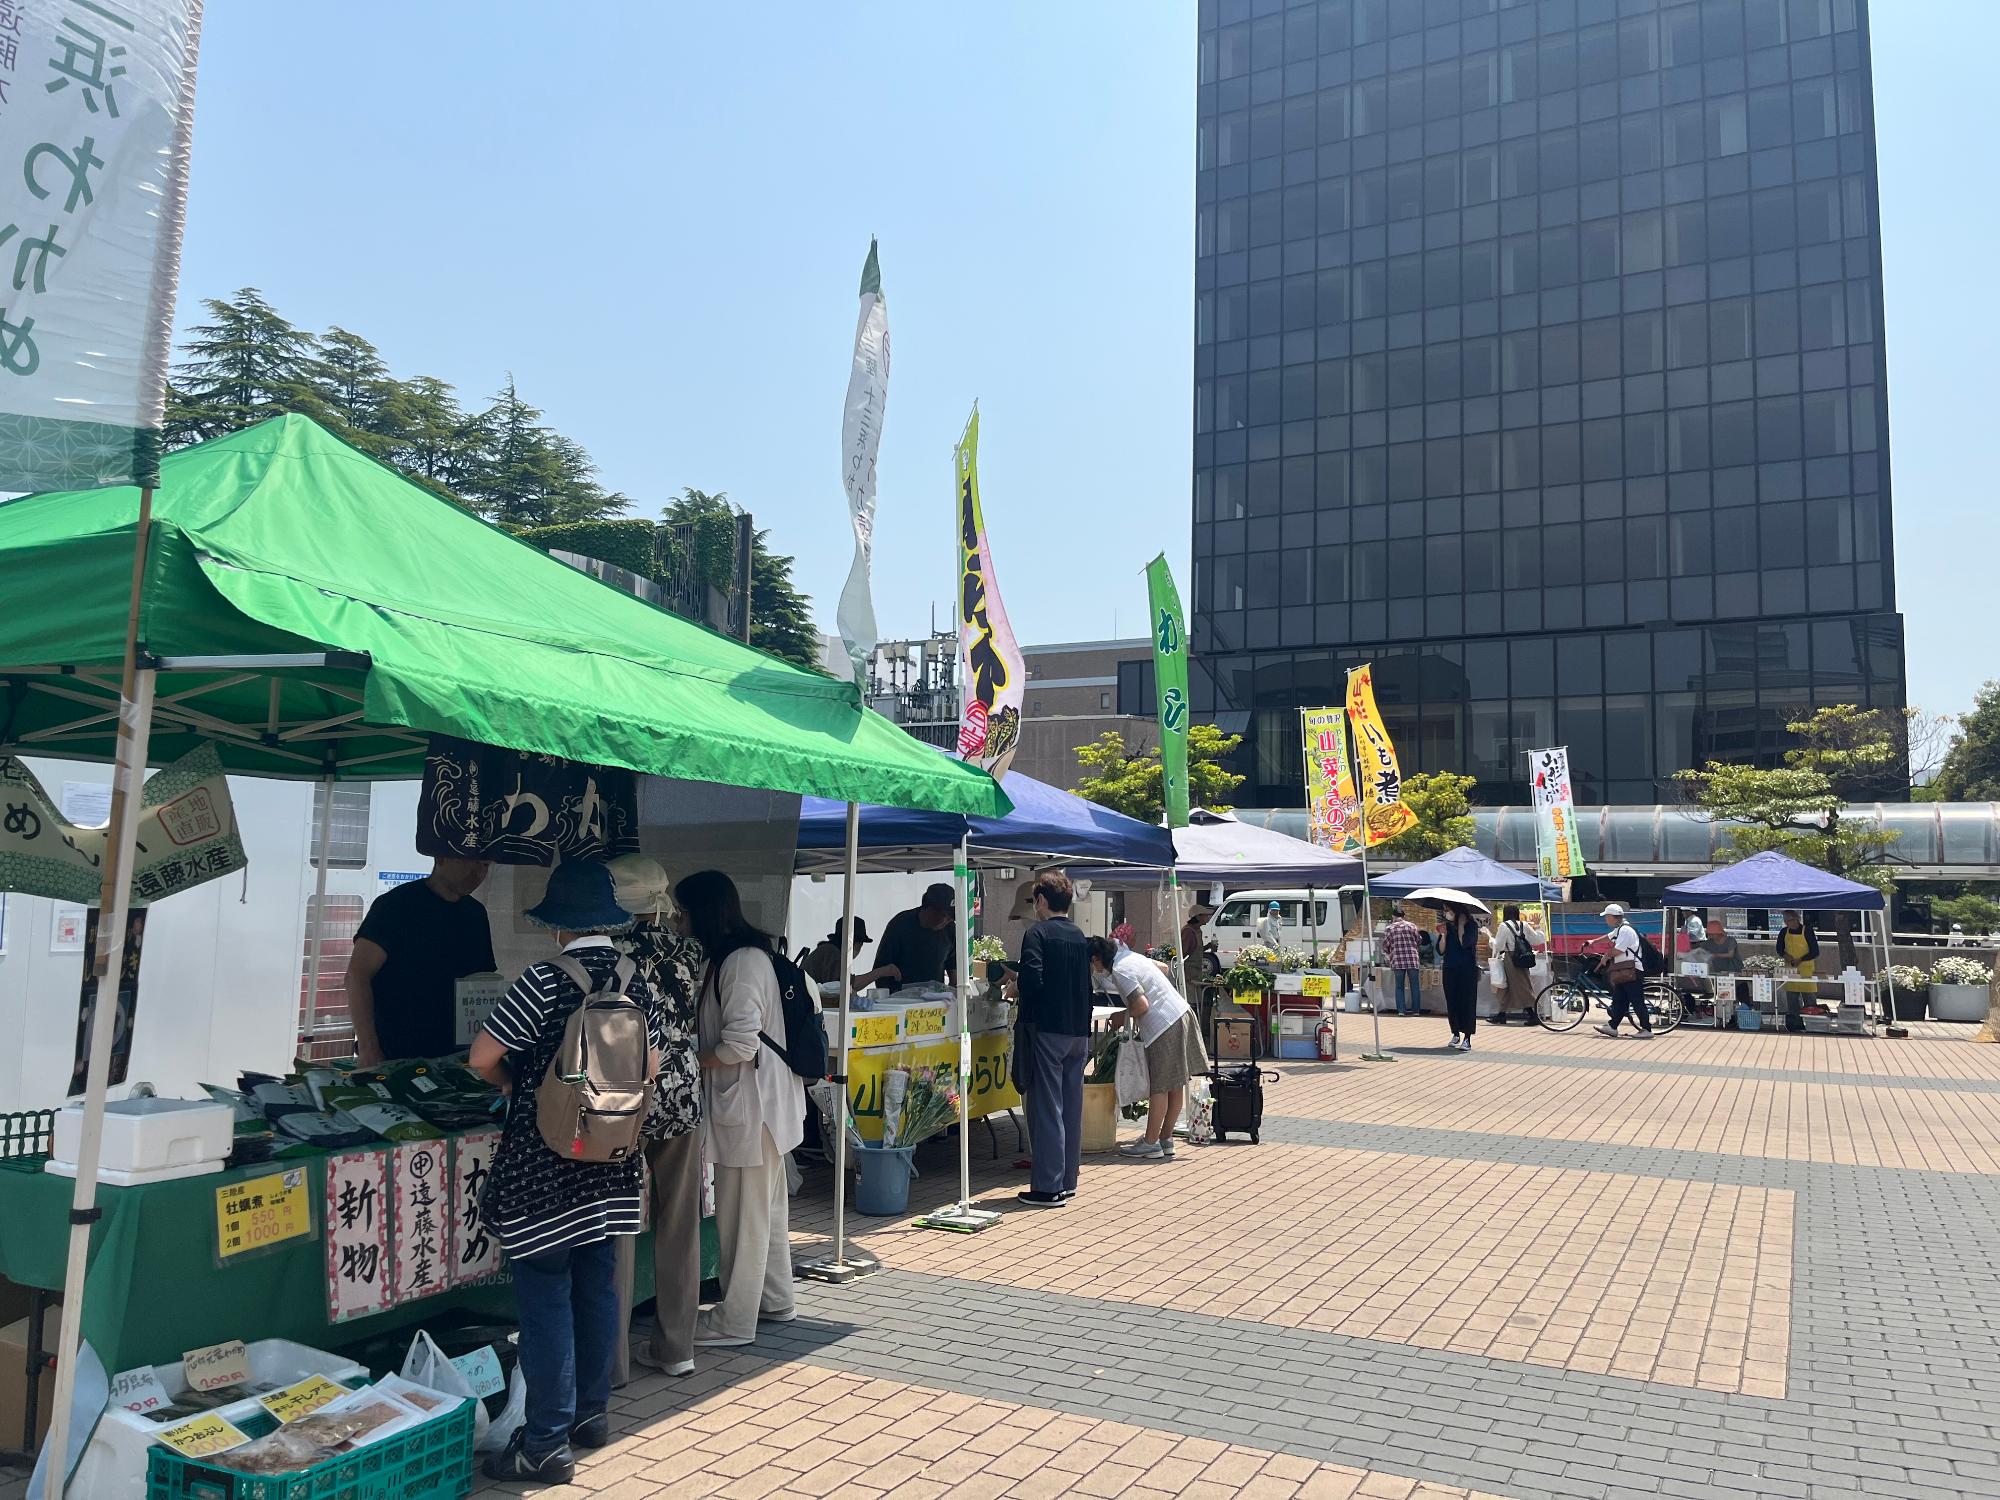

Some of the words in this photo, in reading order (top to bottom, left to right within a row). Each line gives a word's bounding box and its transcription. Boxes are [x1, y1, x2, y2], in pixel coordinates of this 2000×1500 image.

[1319, 729, 1346, 844] 山菜・きのこ
[1362, 723, 1400, 804] いも煮
[131, 846, 233, 897] 遠藤水産
[337, 1179, 379, 1284] 新物
[461, 1157, 490, 1264] わかめ
[173, 1425, 224, 1447] かつおぶし
